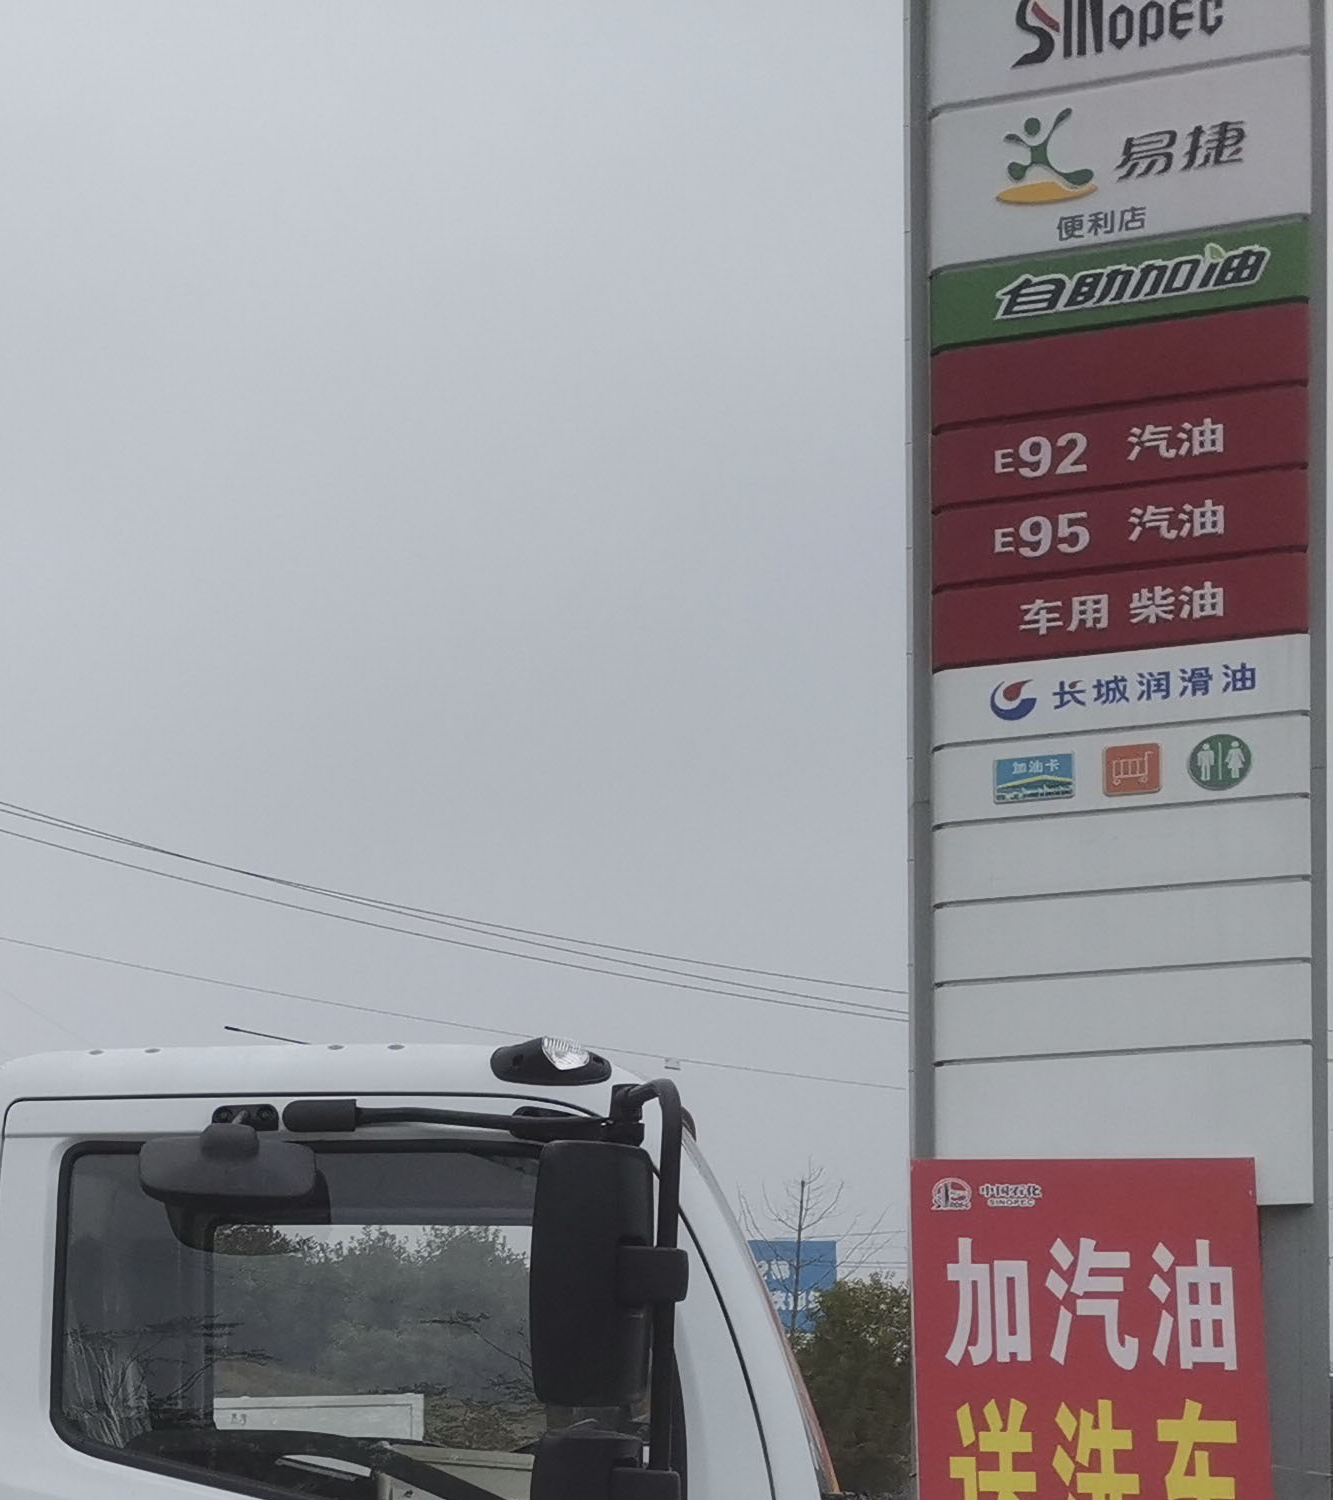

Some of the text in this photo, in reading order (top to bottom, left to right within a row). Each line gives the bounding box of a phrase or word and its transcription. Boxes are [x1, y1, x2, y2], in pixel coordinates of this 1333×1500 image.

[1113, 120, 1247, 183] 易捷
[1056, 206, 1147, 241] 便利店
[995, 246, 1270, 320] 自助加油
[994, 417, 1224, 478] E92 汽油
[994, 499, 1225, 558] E95 汽油
[1019, 580, 1224, 636] 车用 柴油
[1052, 662, 1257, 710] 长城润滑油
[944, 1236, 1238, 1370] 加汽油
